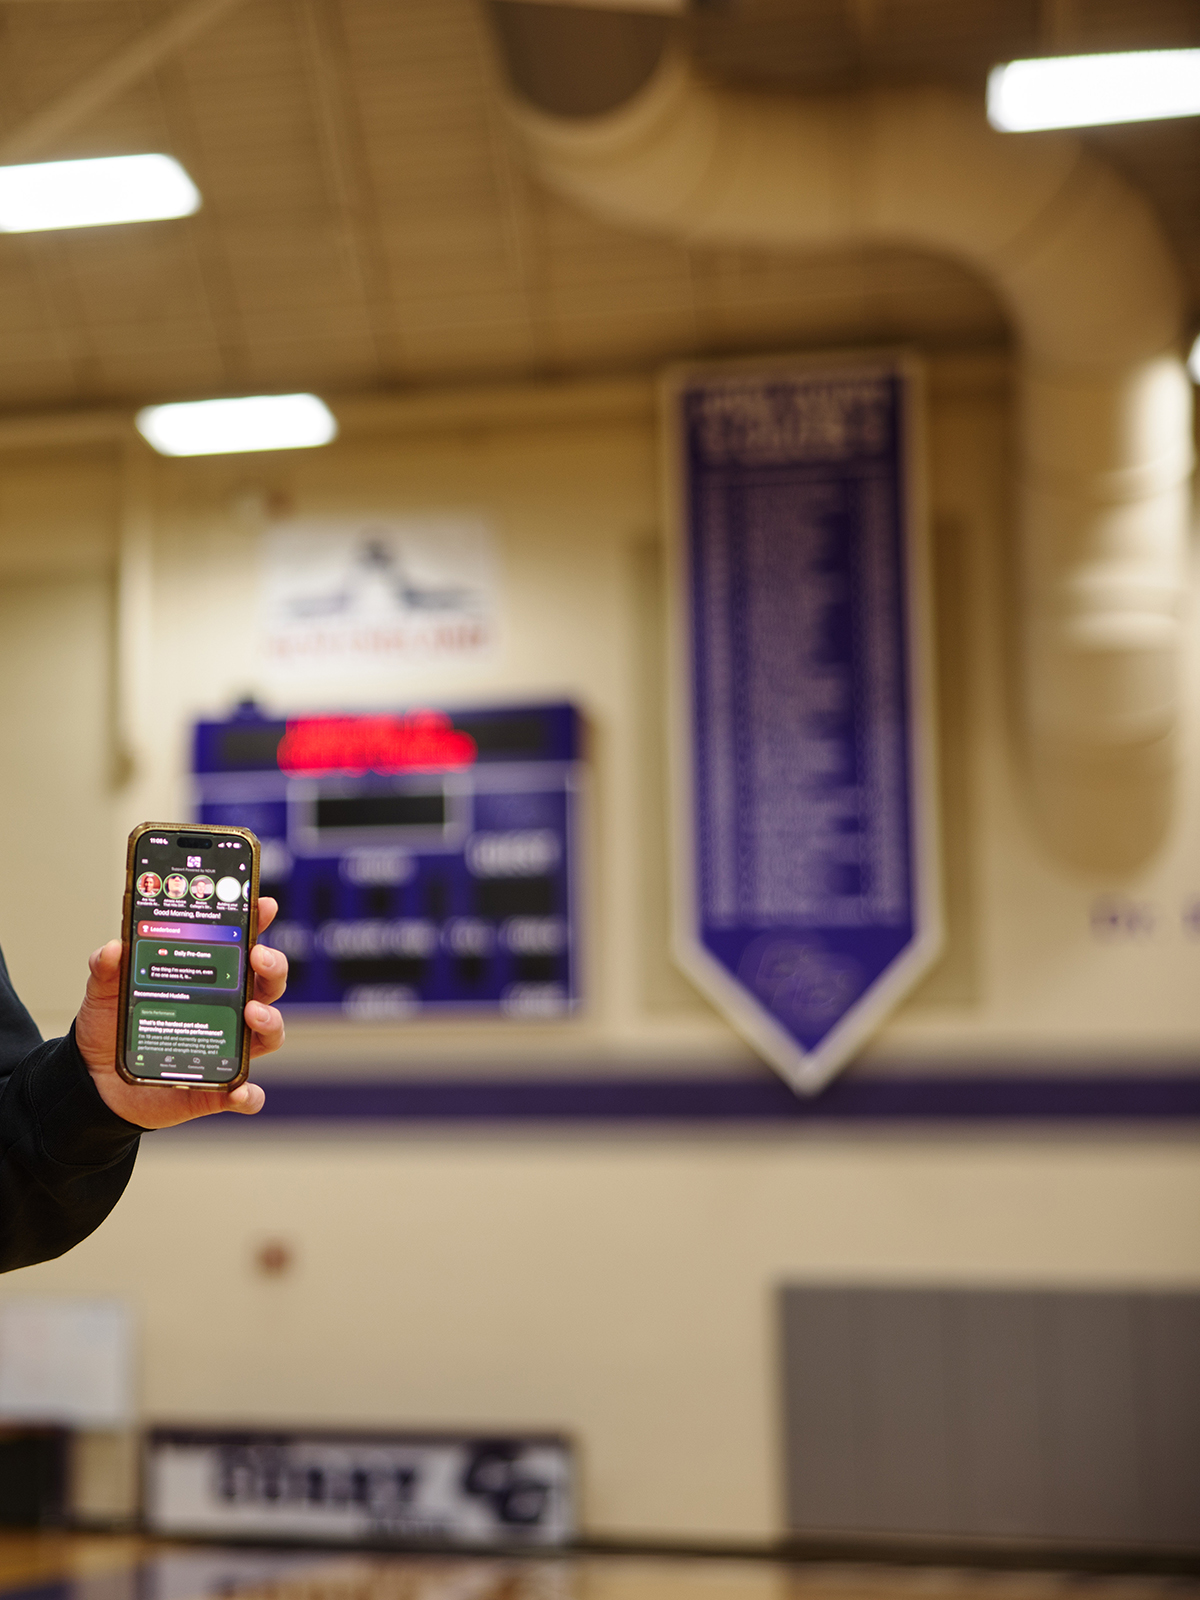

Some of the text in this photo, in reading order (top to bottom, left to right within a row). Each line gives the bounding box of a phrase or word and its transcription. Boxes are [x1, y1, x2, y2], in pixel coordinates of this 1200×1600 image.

[170, 910, 194, 919] Morning,
[195, 911, 221, 919] Brendan!
[150, 926, 181, 934] Leaderboard
[174, 949, 186, 957] Daily
[133, 990, 190, 1000] Recommended Huddles
[138, 1025, 162, 1033] improving
[189, 1029, 223, 1037] performance?
